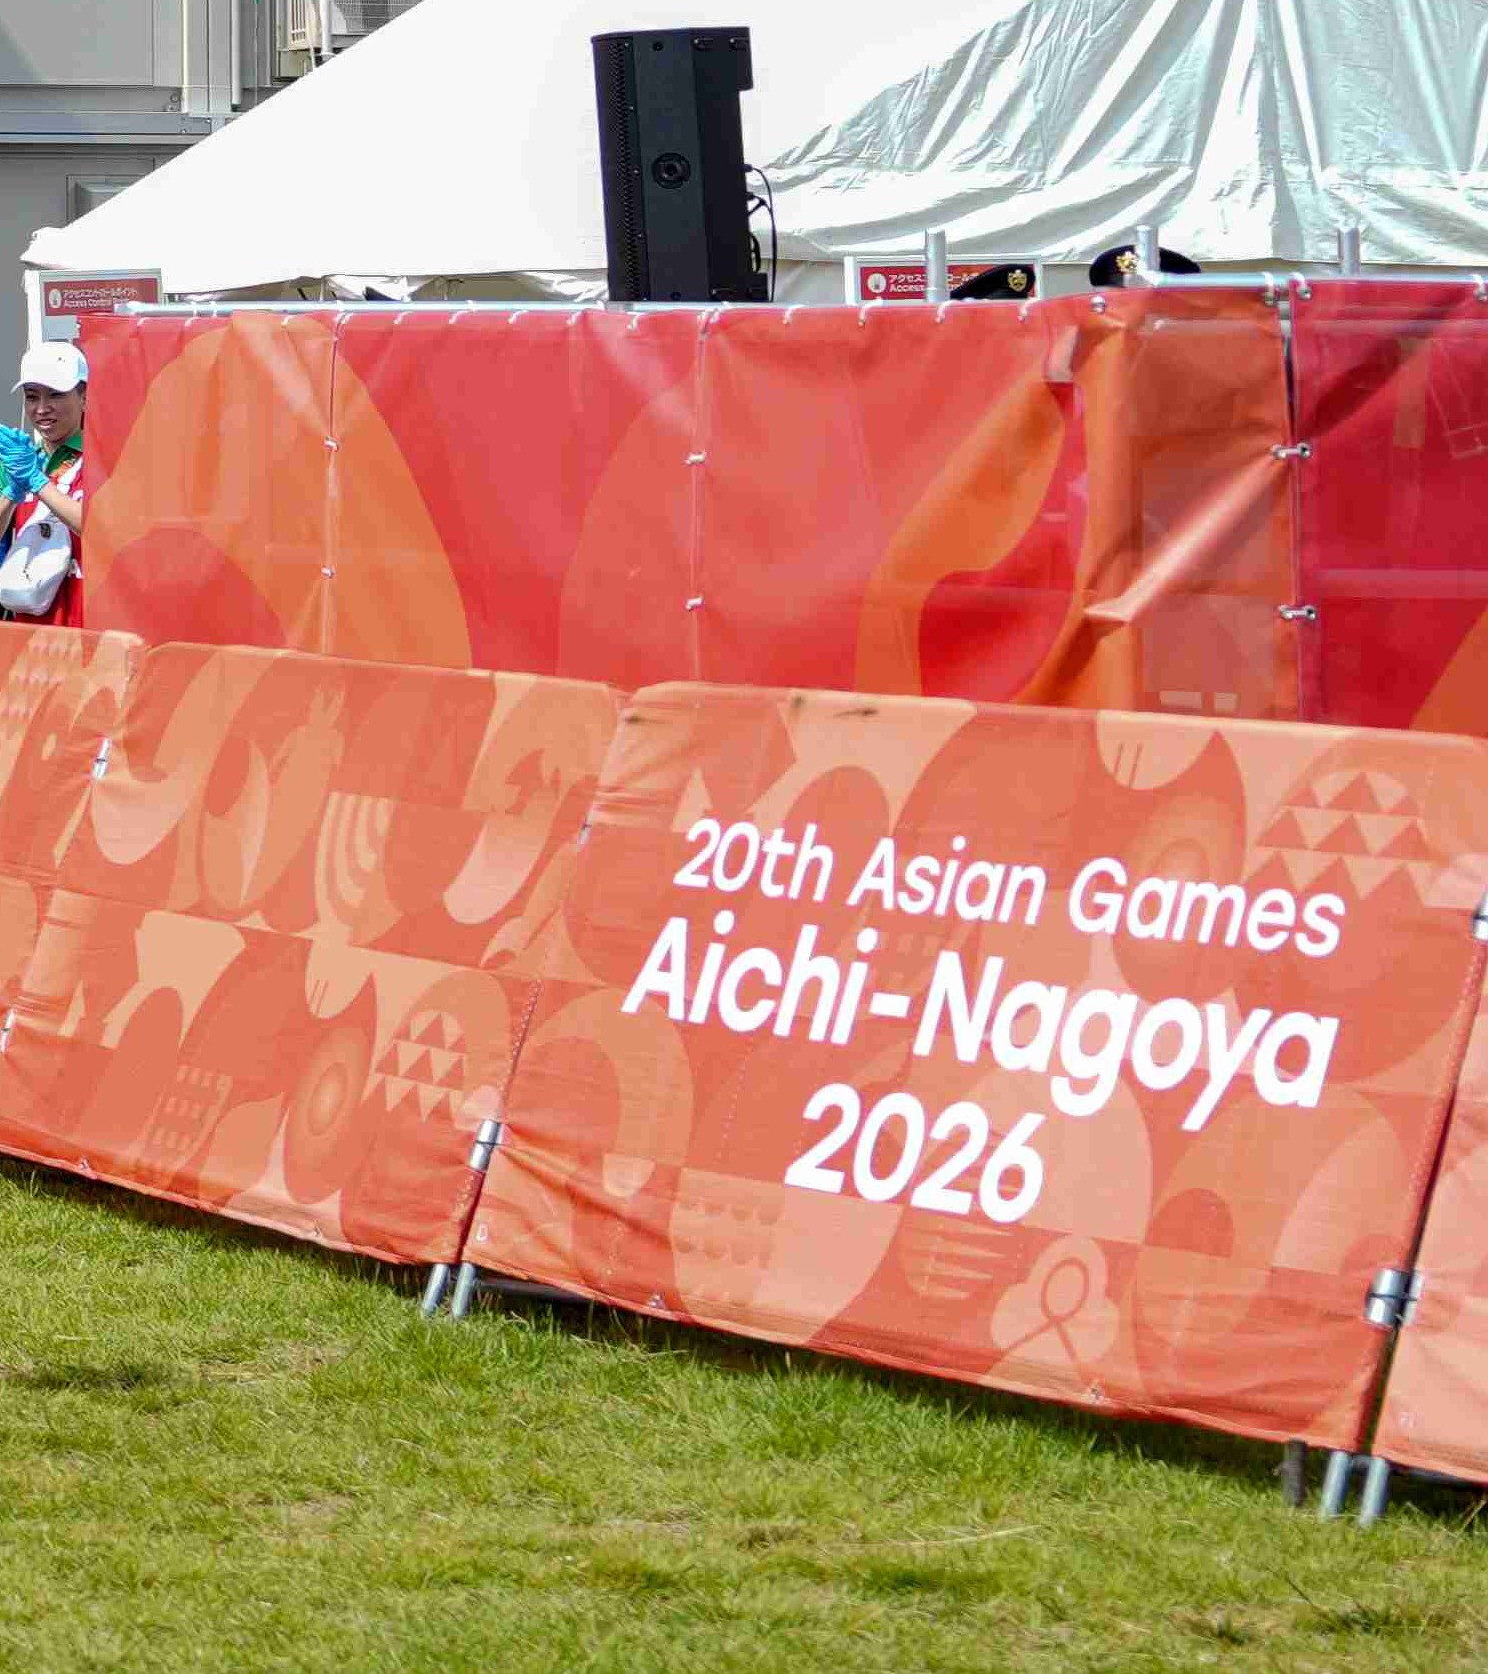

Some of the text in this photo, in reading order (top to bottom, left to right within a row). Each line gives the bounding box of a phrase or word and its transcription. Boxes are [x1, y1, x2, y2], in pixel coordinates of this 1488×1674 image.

[673, 818, 1347, 957] 20th Asian Games
[622, 915, 1339, 1132] Aichi-Nagoya
[785, 1082, 1048, 1224] 2026
